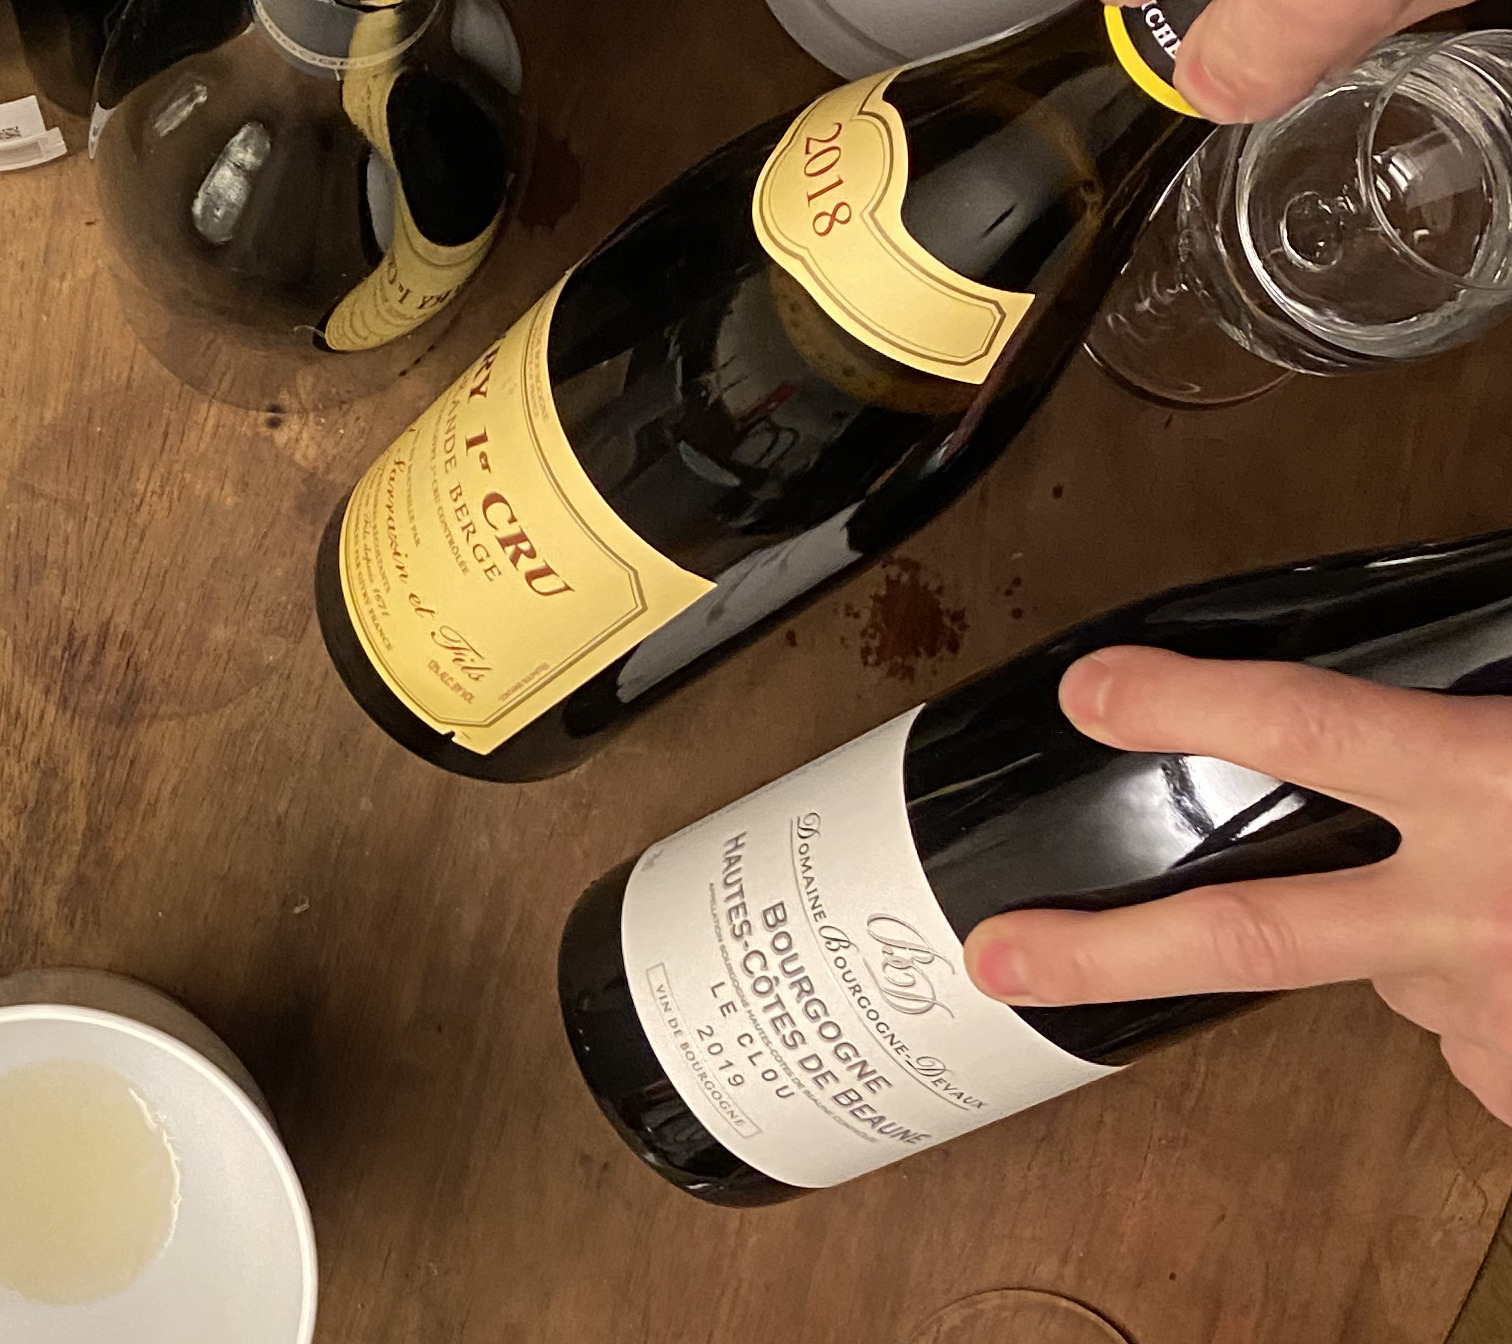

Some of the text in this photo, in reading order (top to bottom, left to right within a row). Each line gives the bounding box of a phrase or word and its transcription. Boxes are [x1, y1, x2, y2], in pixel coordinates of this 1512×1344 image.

[804, 122, 852, 237] 2018
[465, 345, 576, 596] RY 1er CRU
[385, 447, 493, 682] Sarrazin et Fils
[449, 481, 502, 582] BERGE
[368, 607, 393, 653] FRANCE
[719, 943, 750, 1008] BOURGOGNE
[722, 831, 932, 1144] HAUTES-CÔTES DE BEAUNE
[762, 900, 893, 1095] BOURGOGNE
[656, 984, 746, 1127] VIN DE BOURGOGNE
[696, 1024, 745, 1087] 2019
[710, 981, 795, 1099] LE CLOU
